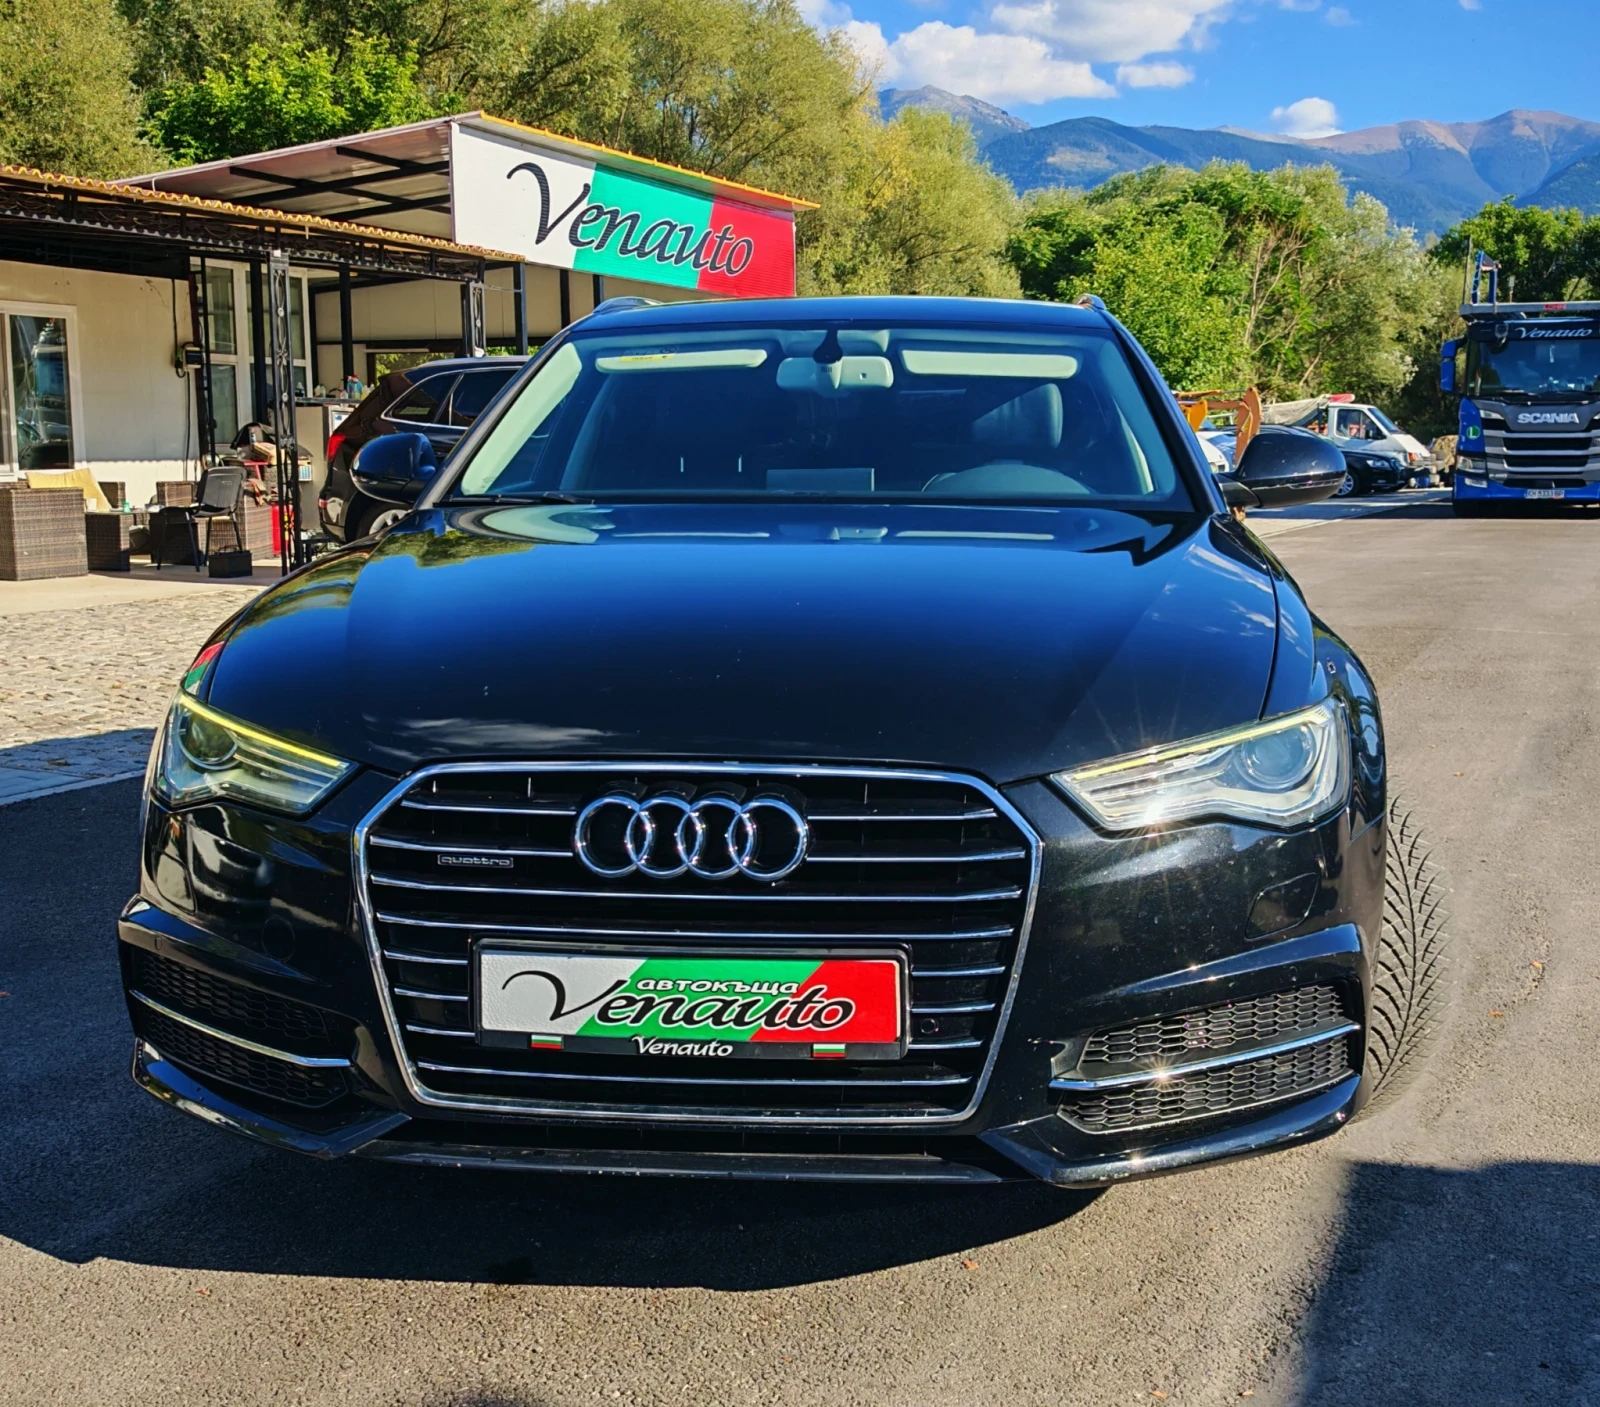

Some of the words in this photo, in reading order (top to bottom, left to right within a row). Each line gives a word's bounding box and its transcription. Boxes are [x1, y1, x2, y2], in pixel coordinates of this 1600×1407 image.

[506, 162, 754, 276] Venauto
[1515, 327, 1592, 338] Venauto
[1517, 412, 1579, 424] SCANIA
[441, 856, 510, 865] quattro
[636, 979, 799, 995] автокъща
[501, 970, 855, 1031] Venauto
[631, 1035, 734, 1057] Venauto
